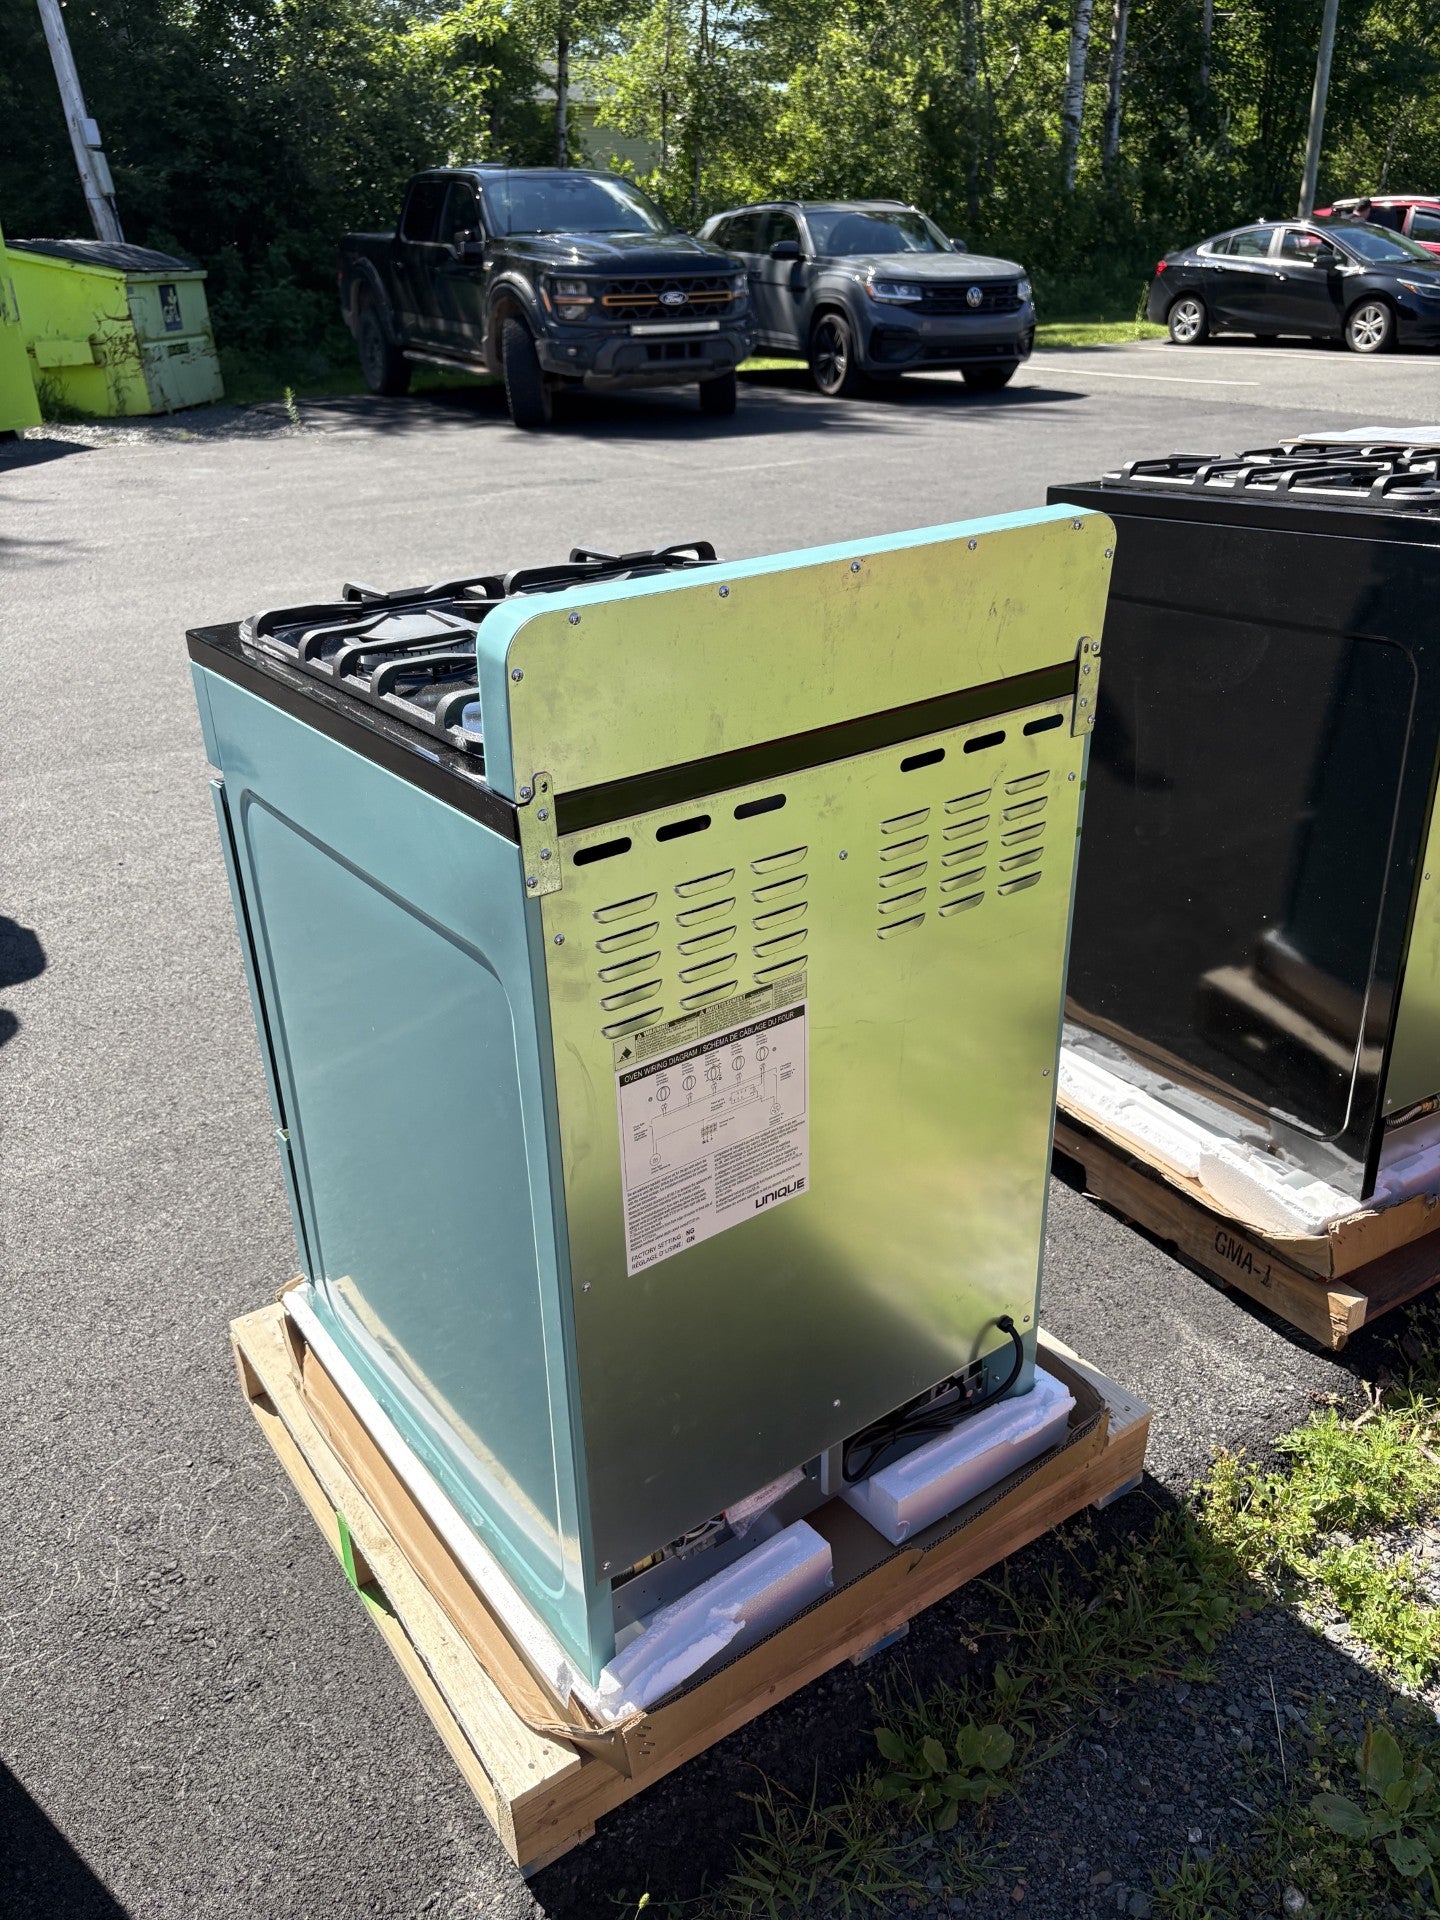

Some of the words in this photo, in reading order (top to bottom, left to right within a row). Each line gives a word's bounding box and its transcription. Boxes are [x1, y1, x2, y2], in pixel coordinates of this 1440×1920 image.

[624, 1070, 643, 1083] OVEN
[643, 1060, 668, 1074] WIRING
[668, 1048, 698, 1065] DIAGRAM
[729, 1033, 739, 1042] DE
[767, 1018, 777, 1027] DU
[777, 1011, 795, 1023] FOUR
[643, 1024, 670, 1037] WARNING
[755, 1177, 805, 1209] UNIQUE
[631, 1246, 656, 1262] FACTORY
[685, 1227, 695, 1237] NG
[686, 1234, 696, 1244] GN
[1214, 1230, 1272, 1288] GMA-1
